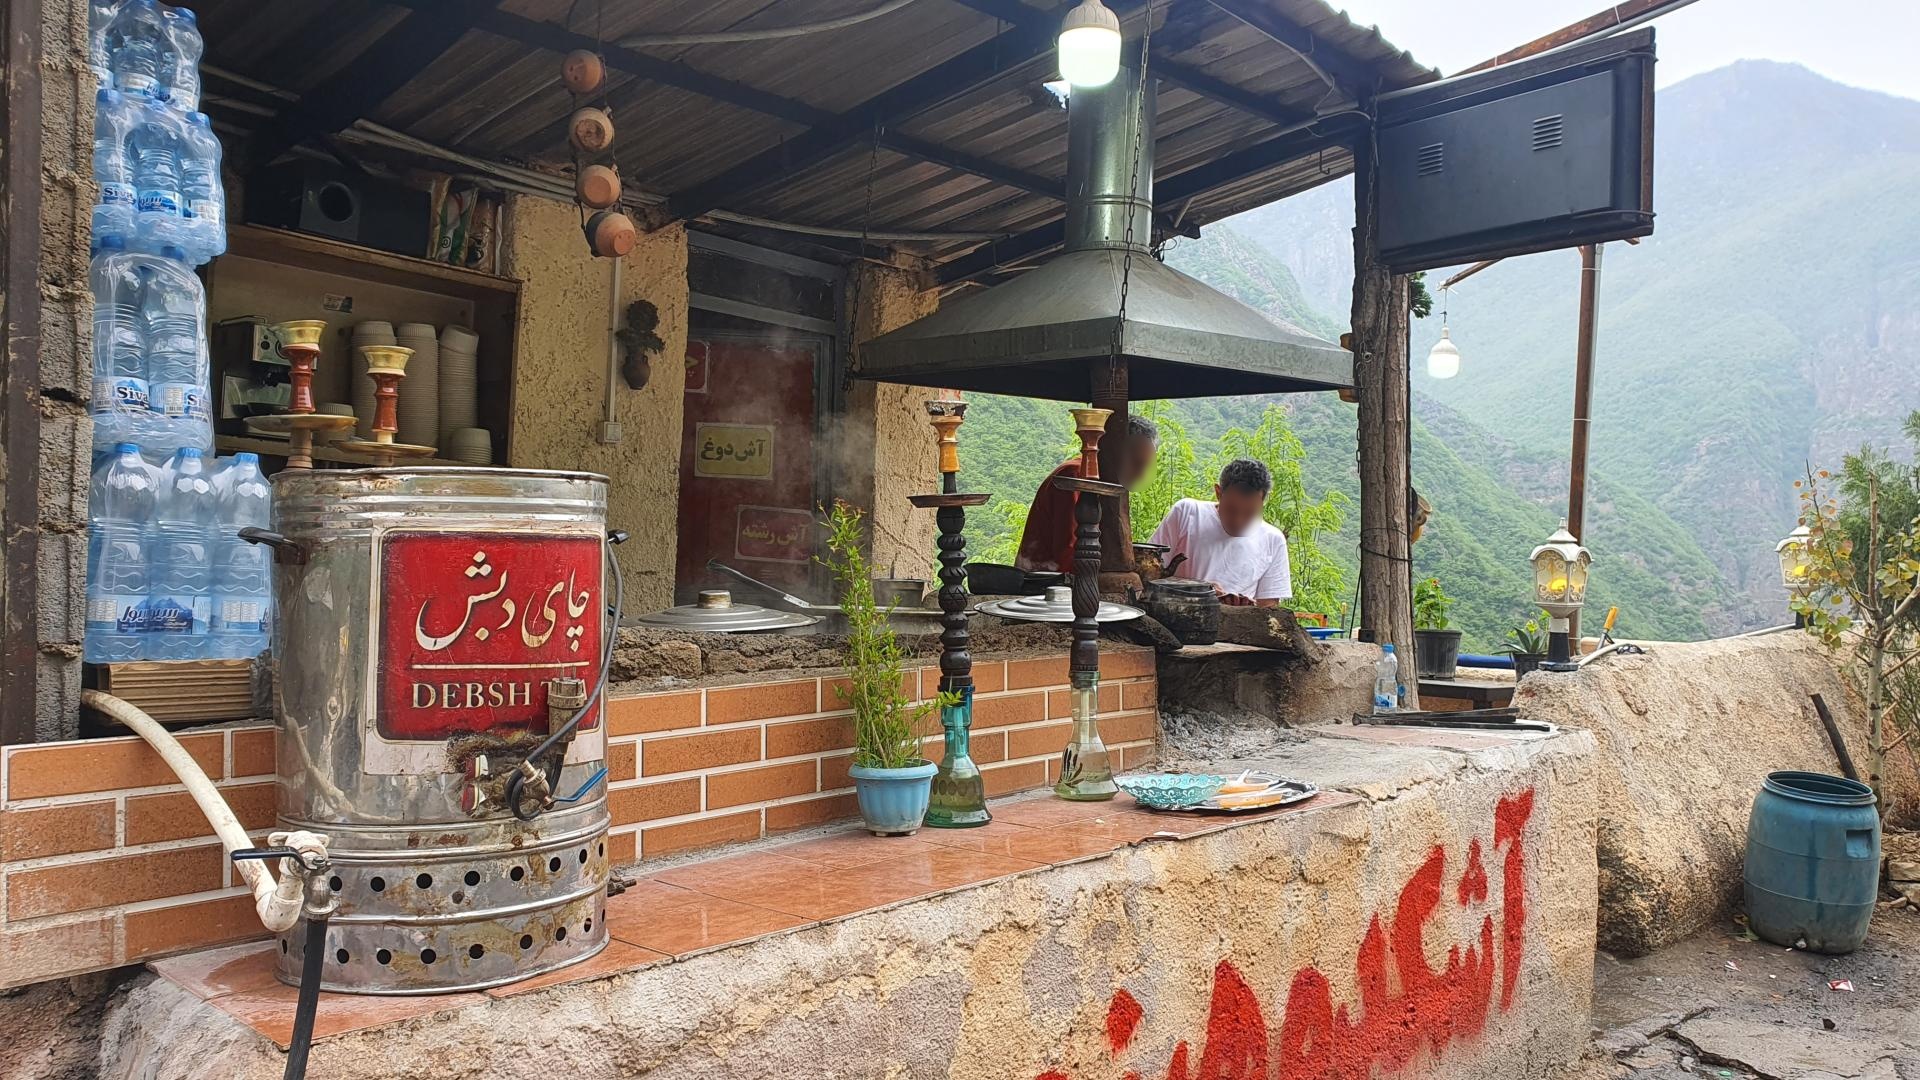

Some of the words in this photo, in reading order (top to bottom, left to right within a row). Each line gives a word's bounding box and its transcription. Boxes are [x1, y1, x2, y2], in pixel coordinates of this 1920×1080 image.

[117, 386, 148, 402] Siva
[701, 437, 734, 461] دوغ
[735, 438, 766, 461] آش
[742, 523, 775, 545] رشته
[777, 523, 809, 546] آش
[415, 550, 516, 651] دبش
[521, 567, 590, 653] چای
[411, 682, 532, 709] DEBSH
